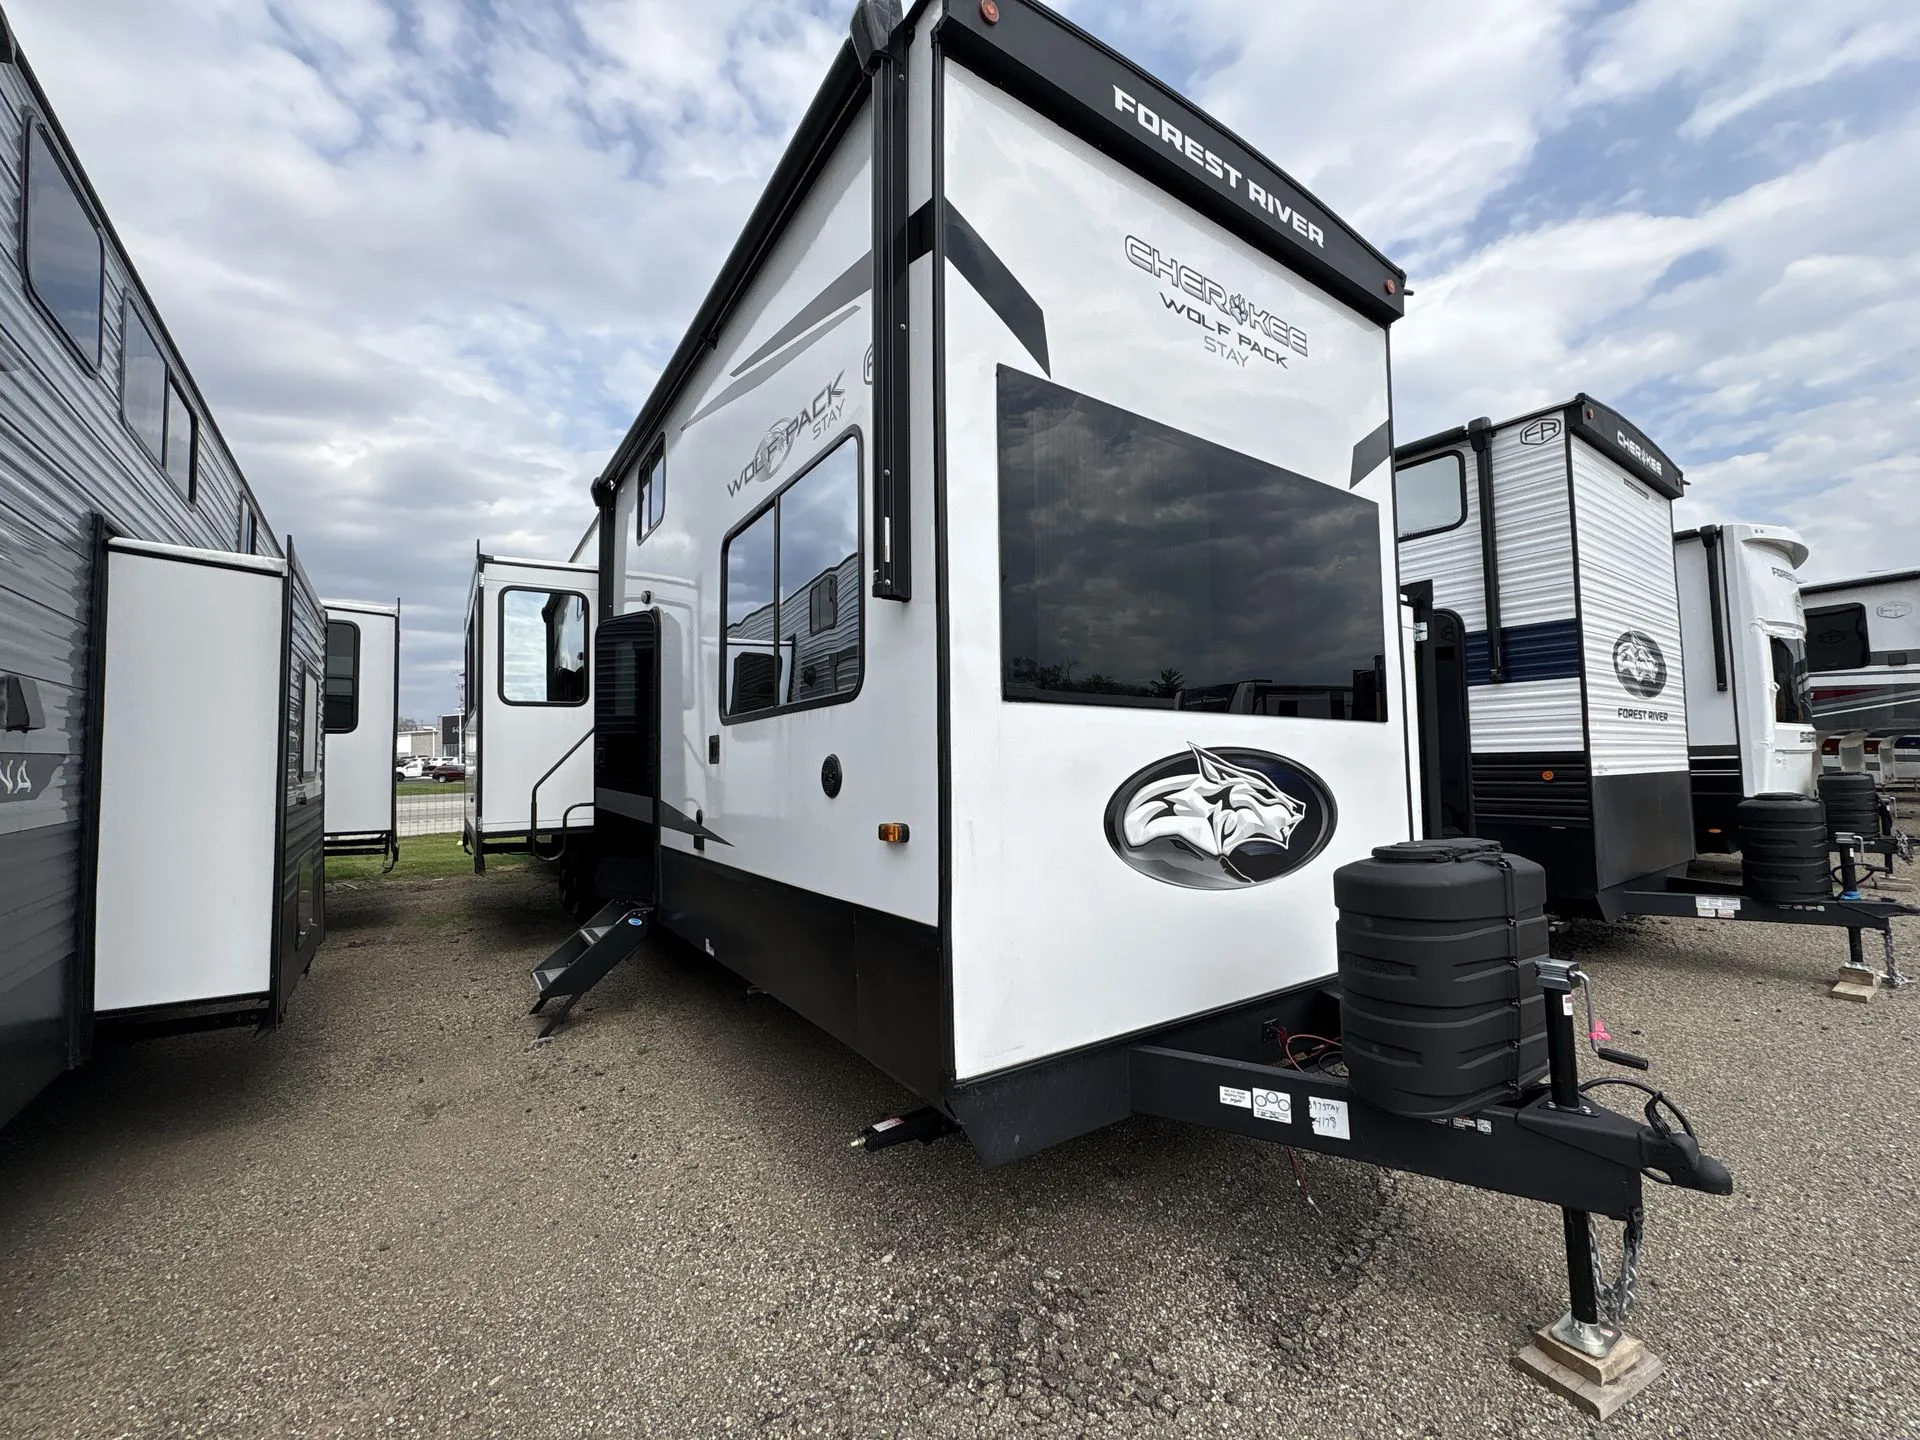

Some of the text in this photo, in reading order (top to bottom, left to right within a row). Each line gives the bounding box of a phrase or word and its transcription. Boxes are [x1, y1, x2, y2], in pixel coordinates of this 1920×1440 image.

[1112, 84, 1325, 249] FOREST RIVER
[1158, 291, 1289, 369] WOLF PACK
[1203, 335, 1250, 368] STAY
[726, 369, 846, 499] WOLF PACK
[812, 398, 846, 441] STAY
[1617, 707, 1669, 722] FOREST RIVER
